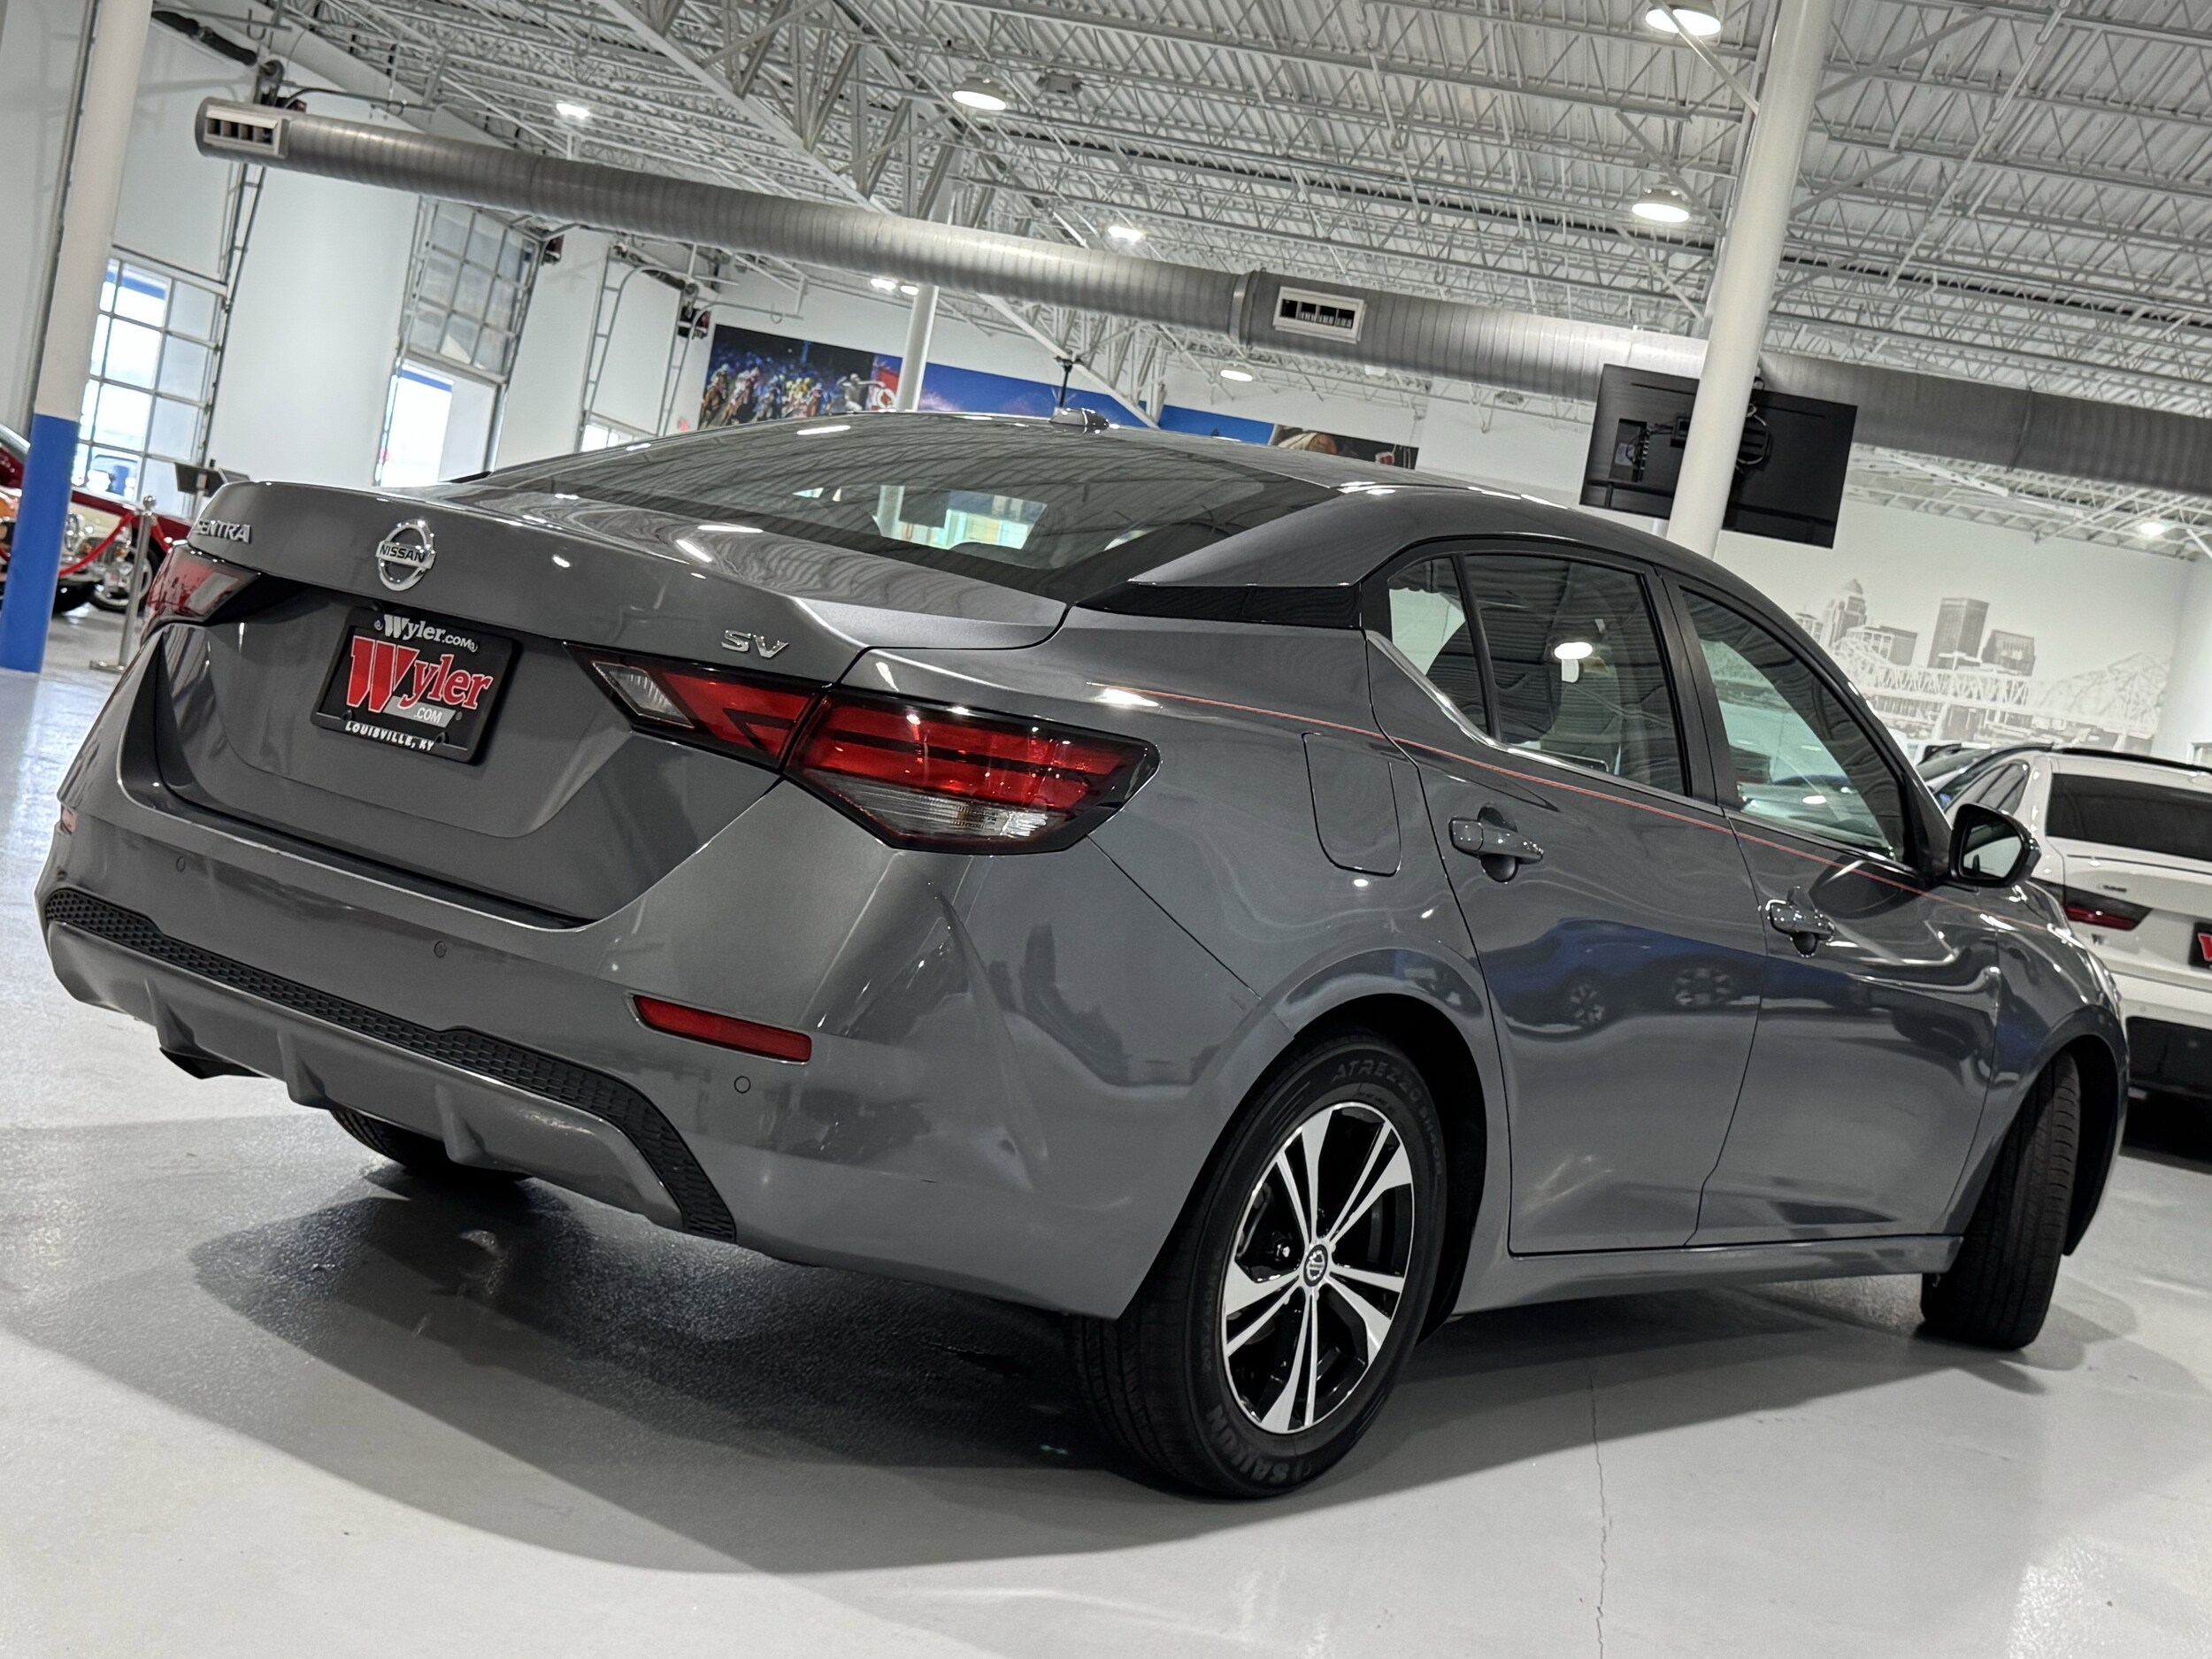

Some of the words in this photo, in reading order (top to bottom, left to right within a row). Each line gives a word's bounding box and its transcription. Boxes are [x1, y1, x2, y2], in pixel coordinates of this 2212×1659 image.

[380, 544, 426, 564] NISSAN
[721, 629, 789, 658] SV
[347, 635, 493, 713] Wyler
[345, 720, 416, 749] LOUISVILLE,
[419, 738, 434, 751] KY
[1331, 1059, 1422, 1102] ATREZZO
[1204, 1403, 1291, 1485] SAILUN
